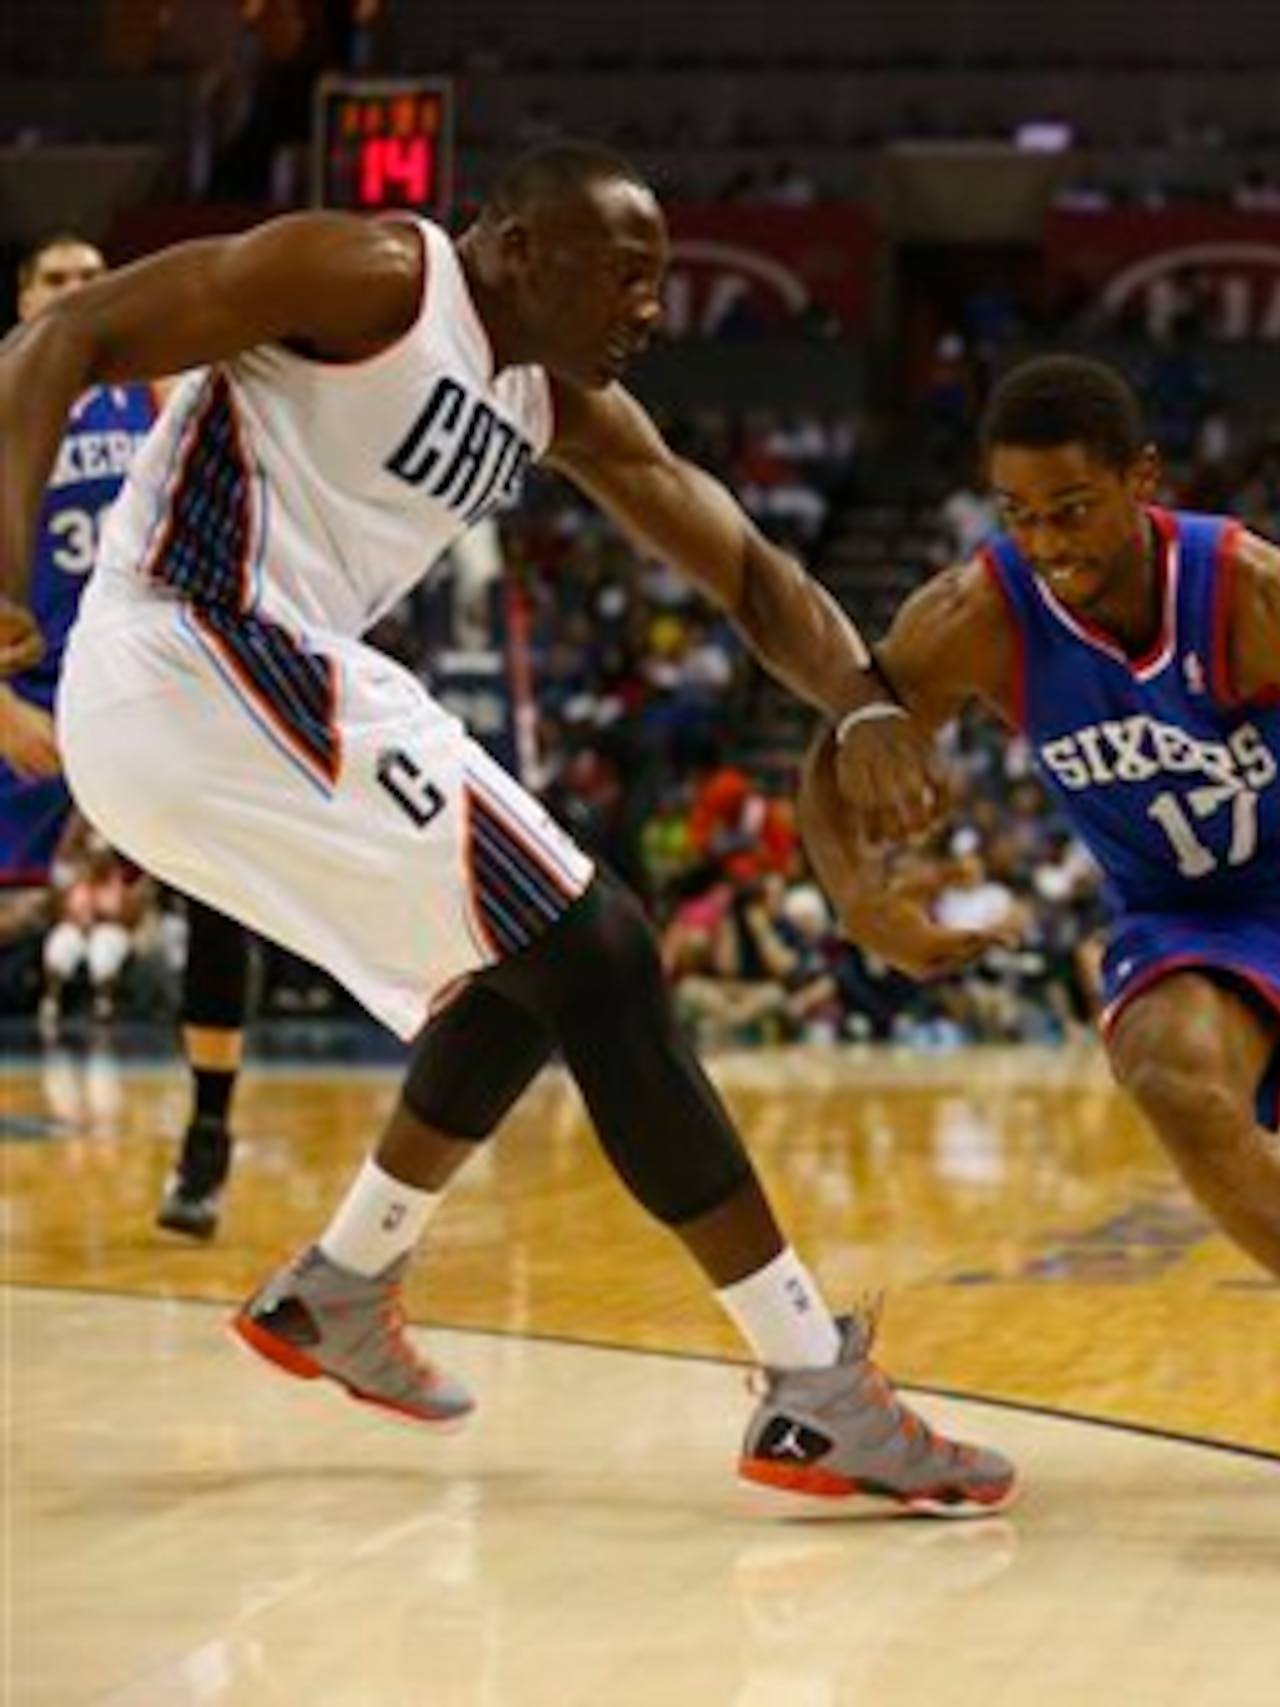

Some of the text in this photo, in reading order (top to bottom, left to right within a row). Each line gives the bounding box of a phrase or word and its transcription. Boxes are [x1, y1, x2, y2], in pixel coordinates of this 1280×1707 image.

[362, 137, 427, 204] 14
[376, 748, 447, 829] C
[1041, 714, 1277, 790] SIXERS
[1147, 782, 1259, 877] 17
